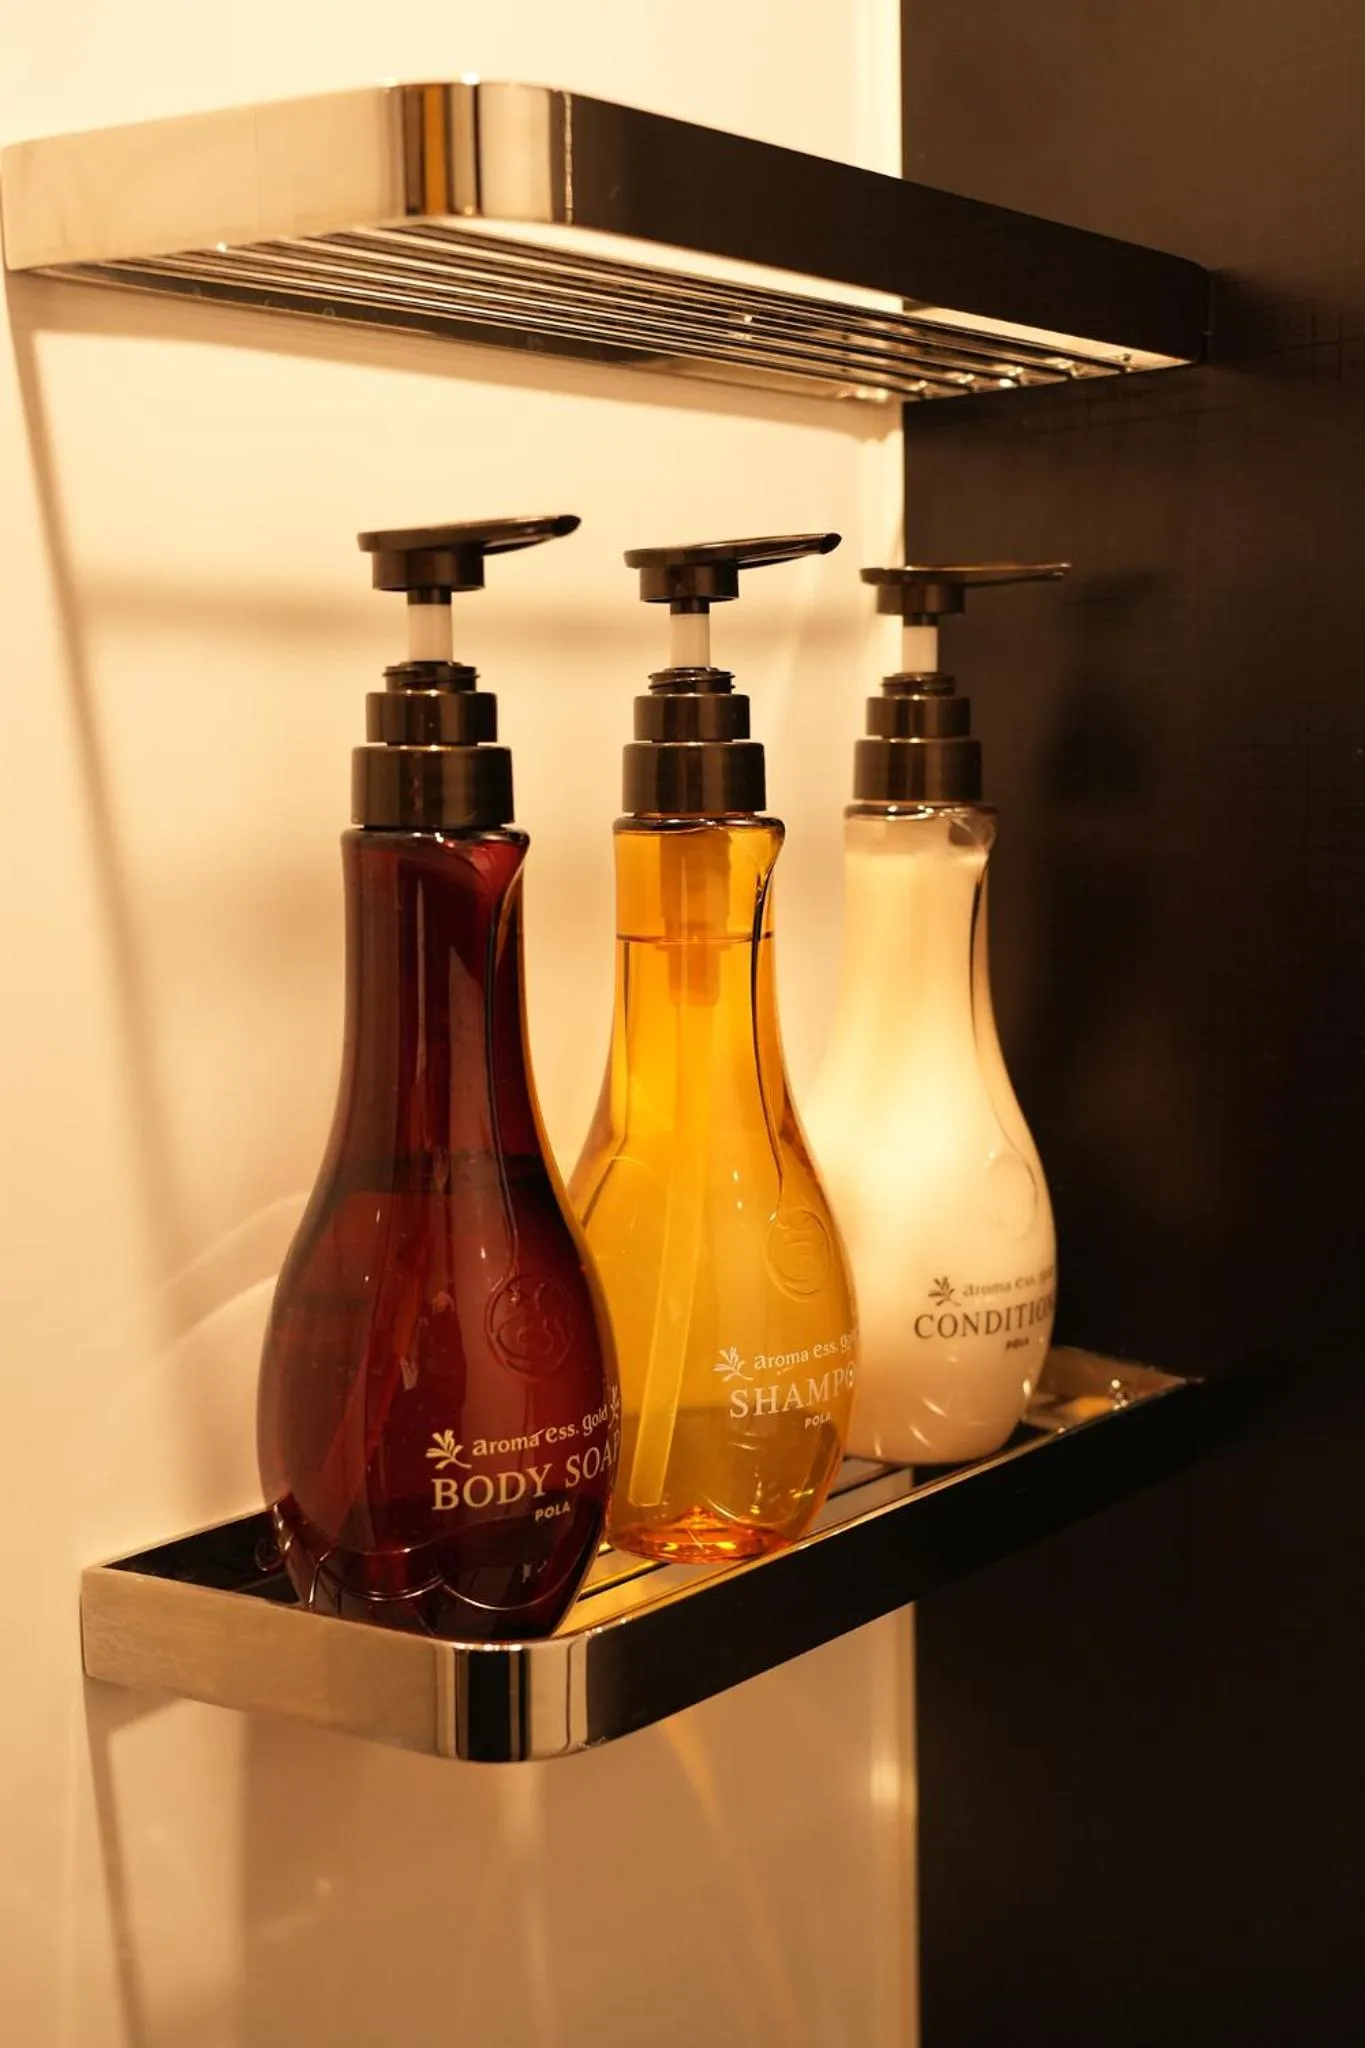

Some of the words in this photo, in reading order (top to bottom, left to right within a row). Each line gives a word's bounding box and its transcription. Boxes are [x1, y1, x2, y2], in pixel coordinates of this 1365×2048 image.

[962, 1281, 1012, 1298] aroma
[754, 1350, 809, 1371] aroma
[472, 1433, 540, 1457] aroma
[545, 1423, 579, 1444] ess.
[582, 1404, 608, 1437] gold
[804, 1412, 832, 1430] POLA
[431, 1463, 553, 1511] BODY
[534, 1501, 571, 1522] POLA
